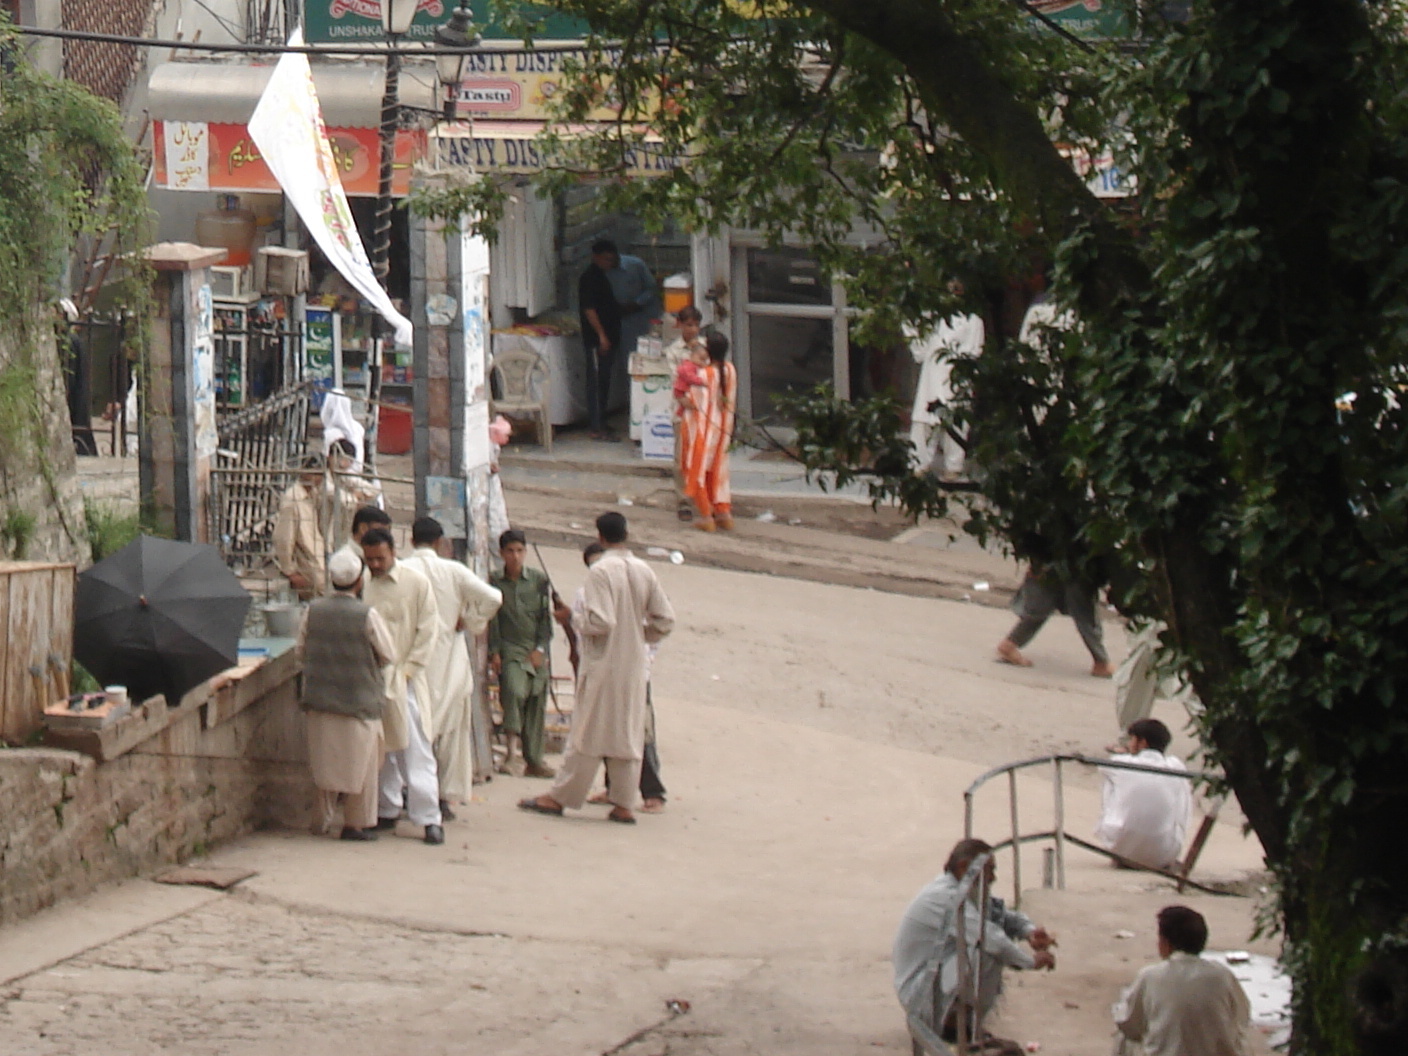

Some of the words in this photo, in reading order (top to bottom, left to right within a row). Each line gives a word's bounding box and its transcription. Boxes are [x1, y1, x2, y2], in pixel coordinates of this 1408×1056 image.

[328, 24, 385, 38] UNSHAKA
[408, 24, 436, 37] TRUS
[466, 52, 507, 74] ASTY
[460, 89, 511, 104] Tasty
